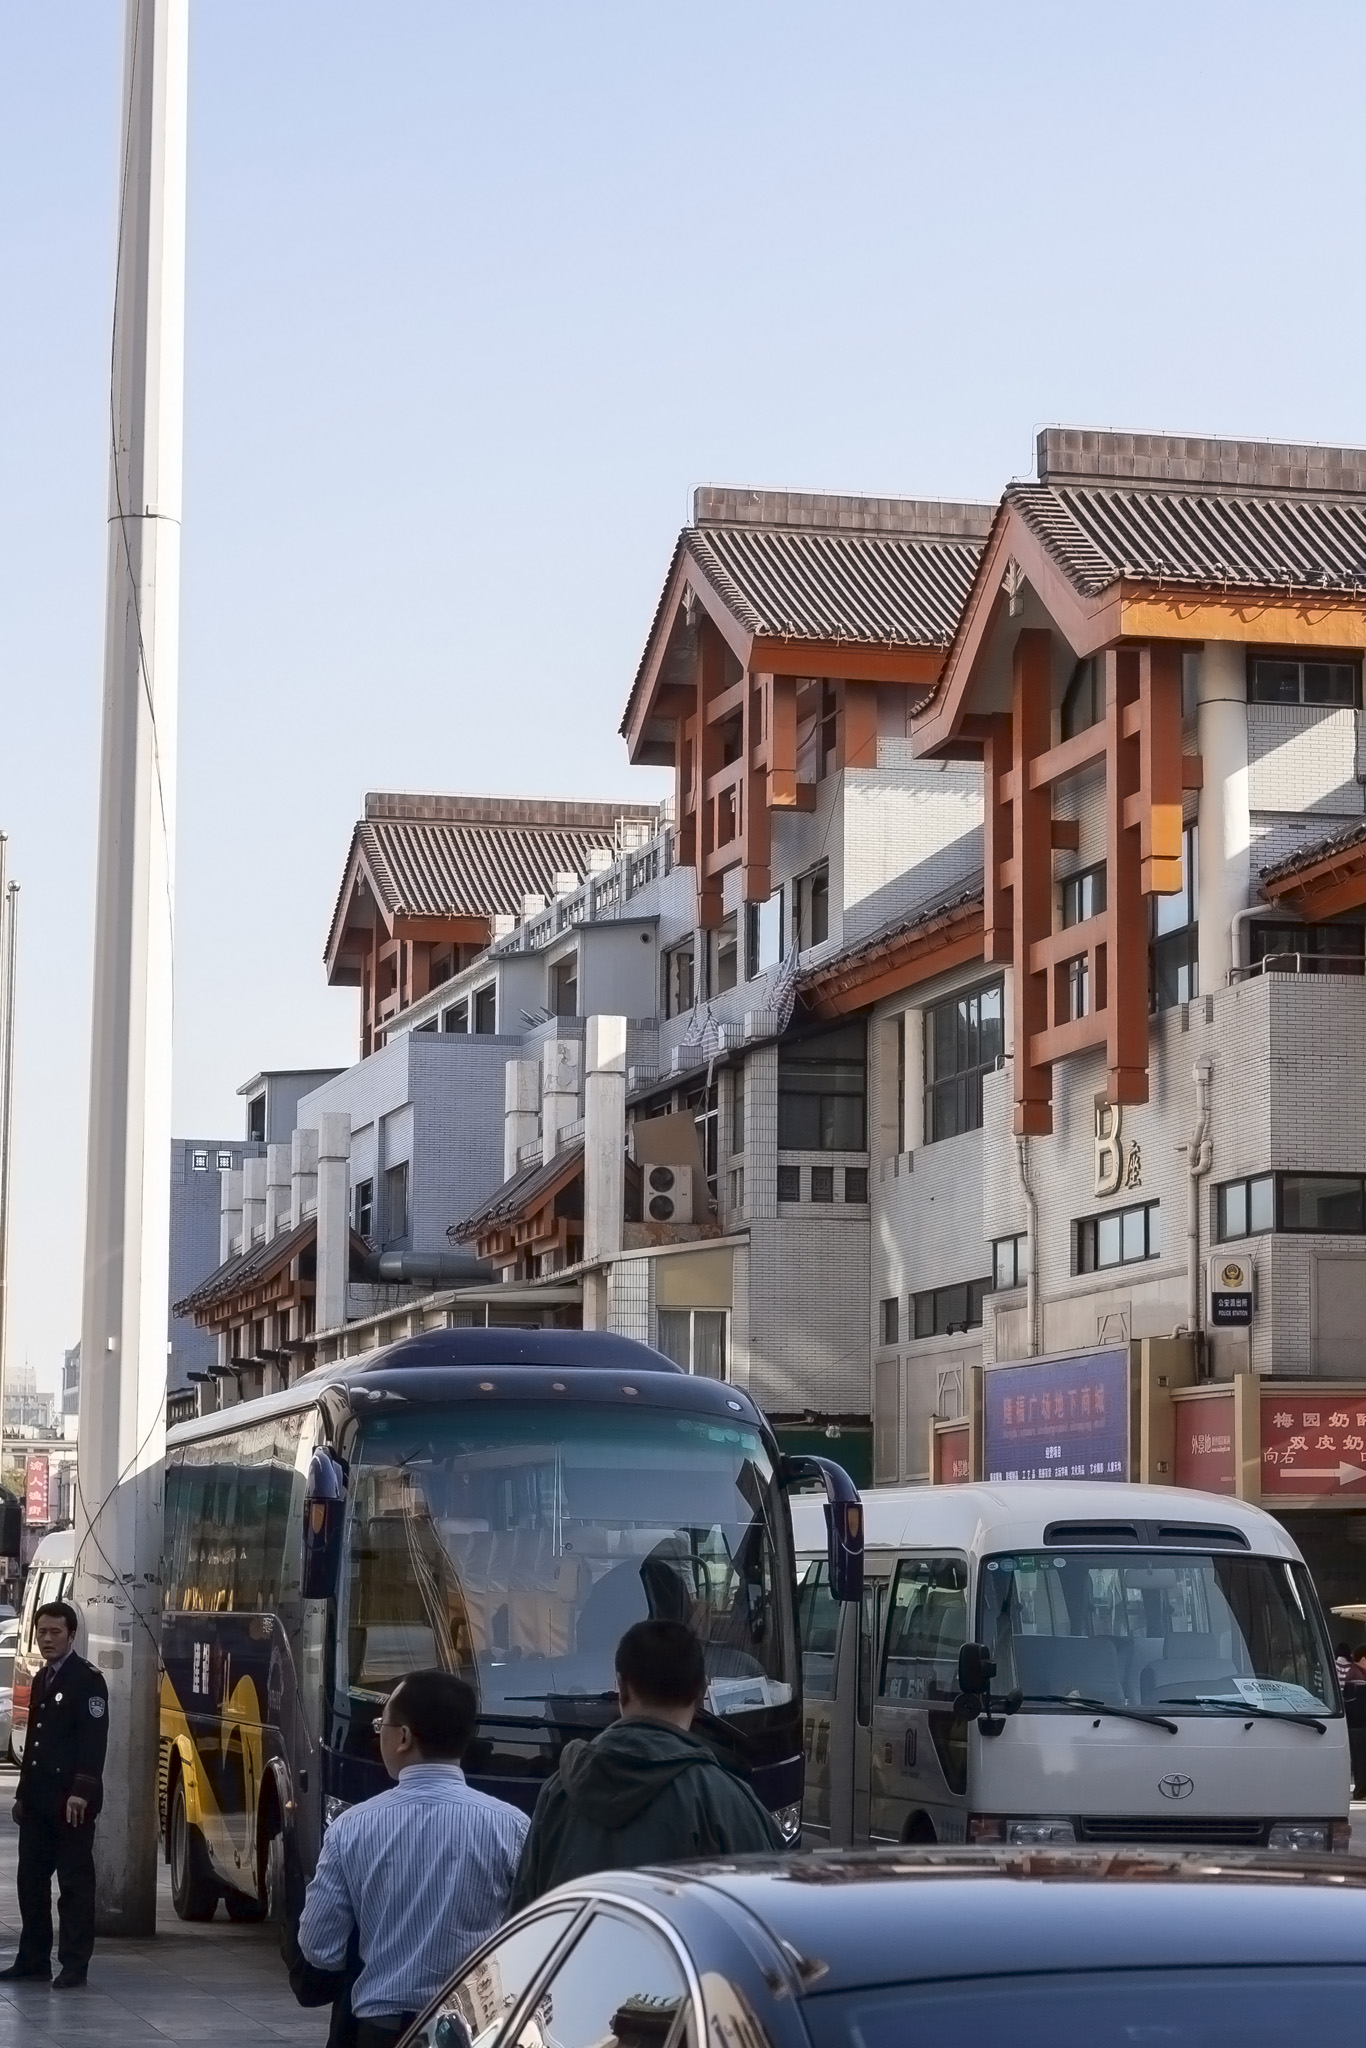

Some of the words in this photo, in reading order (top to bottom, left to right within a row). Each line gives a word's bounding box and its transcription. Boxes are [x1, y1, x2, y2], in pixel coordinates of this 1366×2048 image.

[1218, 1298, 1248, 1307] 公安派出所
[1192, 1434, 1212, 1454] 外景地
[1289, 1434, 1364, 1451] 双皮奶
[1263, 1447, 1297, 1465] 向右
